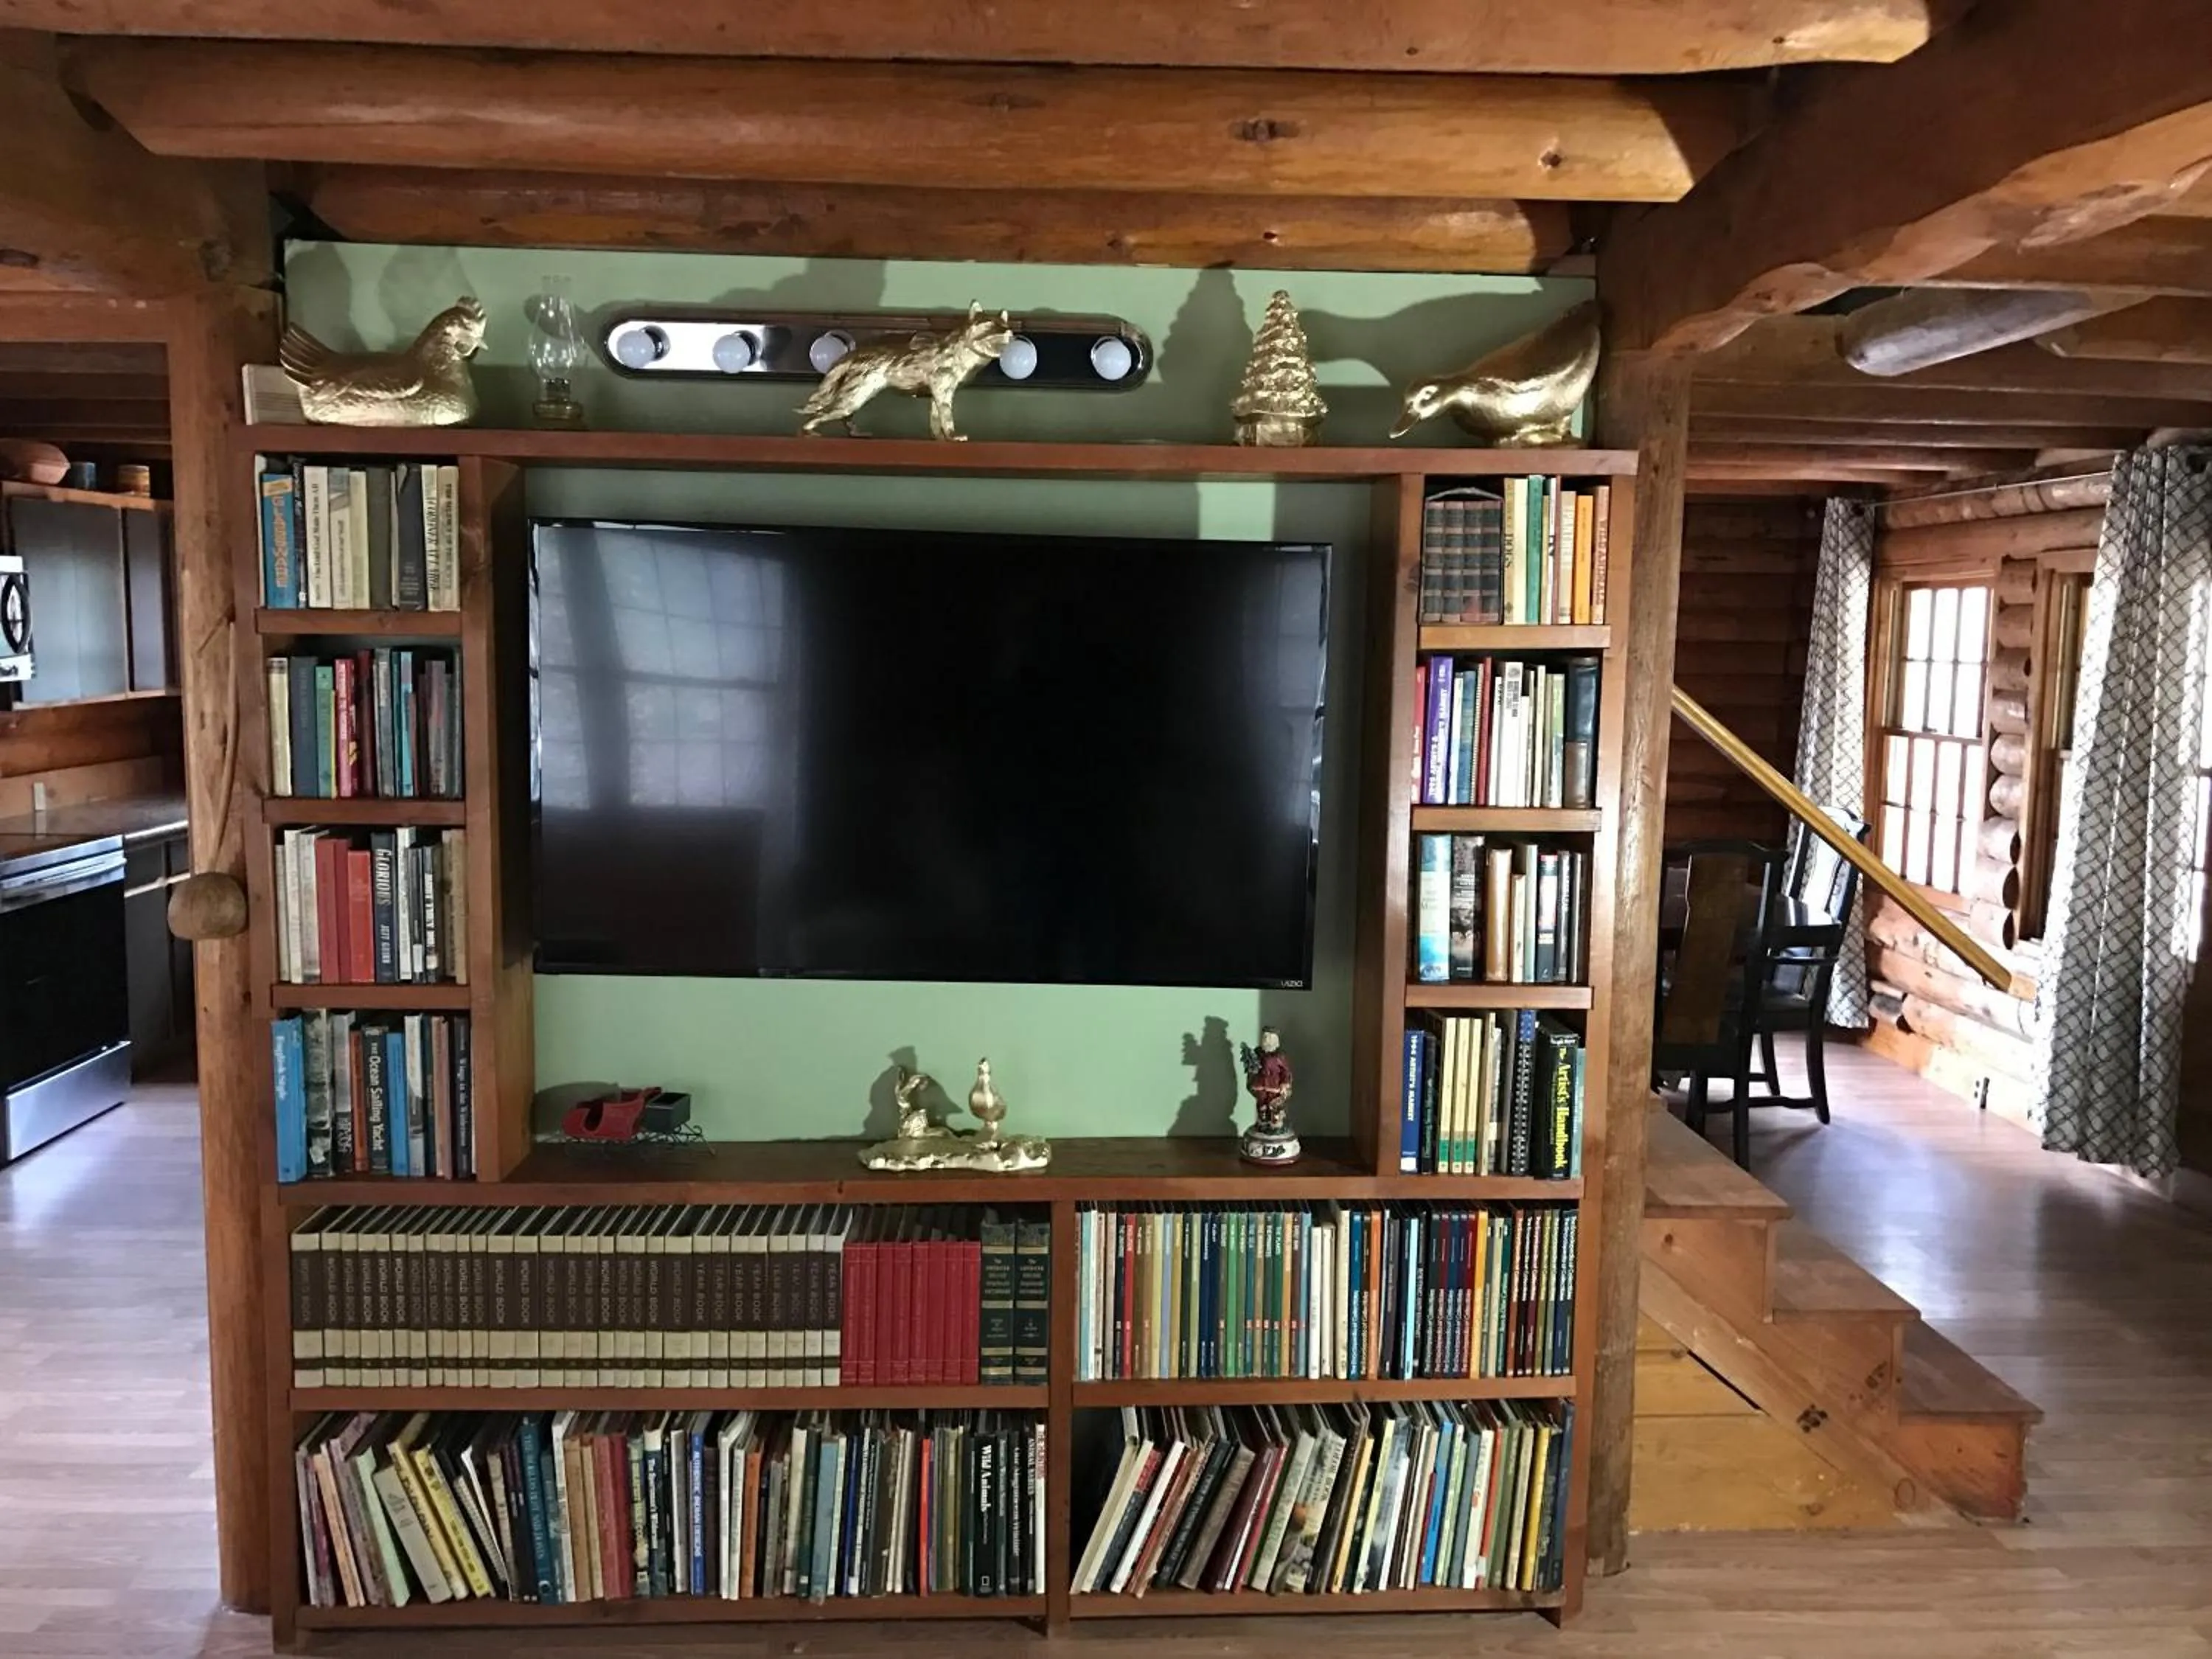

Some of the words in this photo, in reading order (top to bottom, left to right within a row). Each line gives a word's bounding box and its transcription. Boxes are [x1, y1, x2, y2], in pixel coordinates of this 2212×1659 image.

[375, 848, 392, 906] GLORIOUS
[274, 1035, 286, 1074] English
[369, 1055, 381, 1086] Ocean
[274, 1075, 287, 1101] Style
[1409, 1057, 1417, 1089] ARTIST'S
[1557, 1062, 1571, 1103] Artist's
[369, 1087, 383, 1121] Sailing
[1408, 1089, 1416, 1121] MARKET
[372, 1123, 384, 1151] Yacht
[1554, 1107, 1570, 1169] Handbook
[693, 1451, 701, 1495] AUTHENTIC
[981, 1444, 992, 1469] Wild
[981, 1471, 992, 1512] Animals
[694, 1495, 702, 1524] INDIAN
